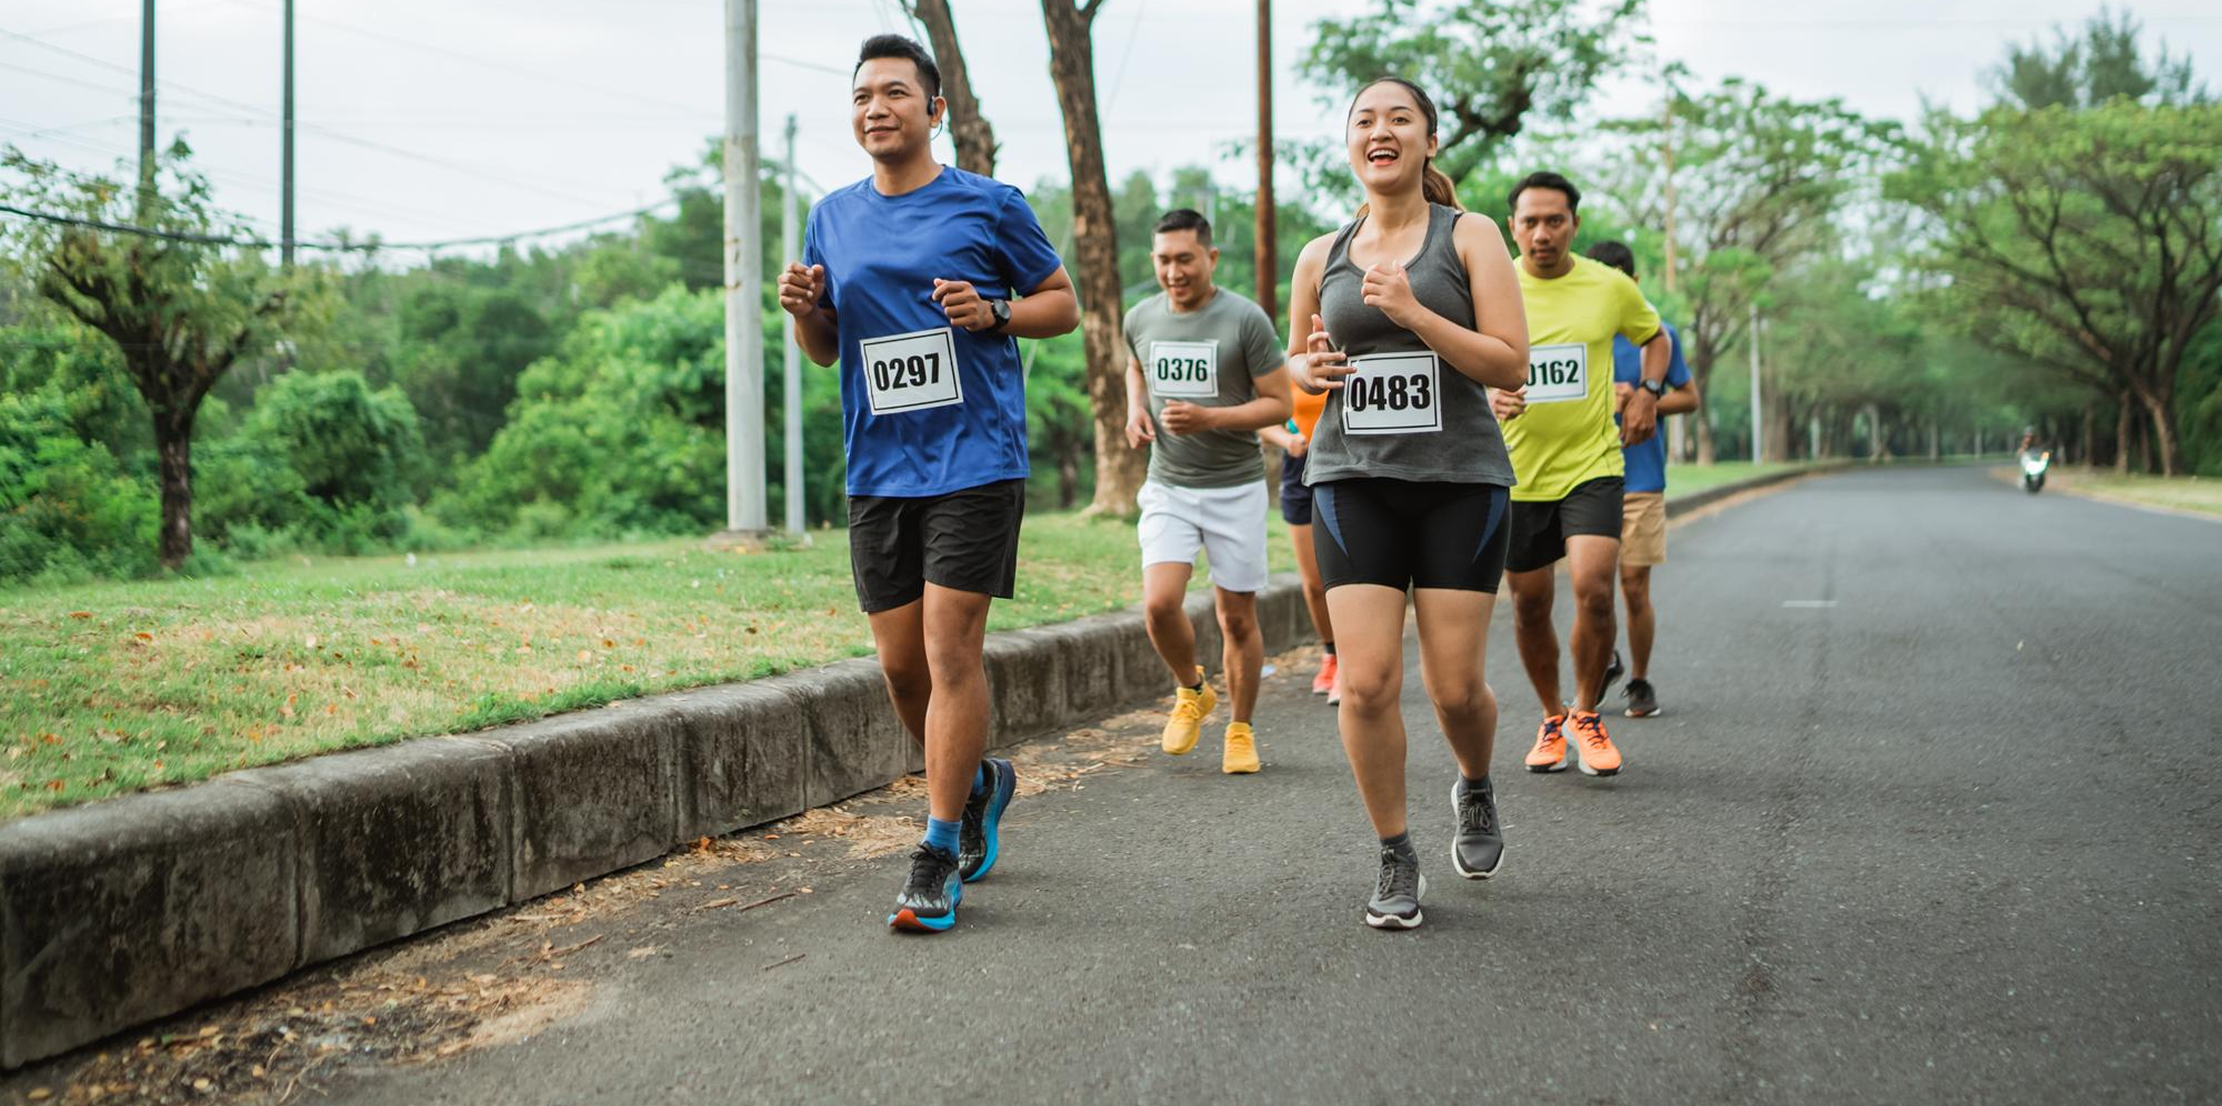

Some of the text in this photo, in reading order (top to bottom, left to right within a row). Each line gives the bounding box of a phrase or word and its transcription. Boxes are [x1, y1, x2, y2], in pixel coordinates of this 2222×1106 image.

[873, 353, 940, 391] 0297
[1158, 358, 1208, 382] 0376
[1350, 374, 1431, 412] 0483
